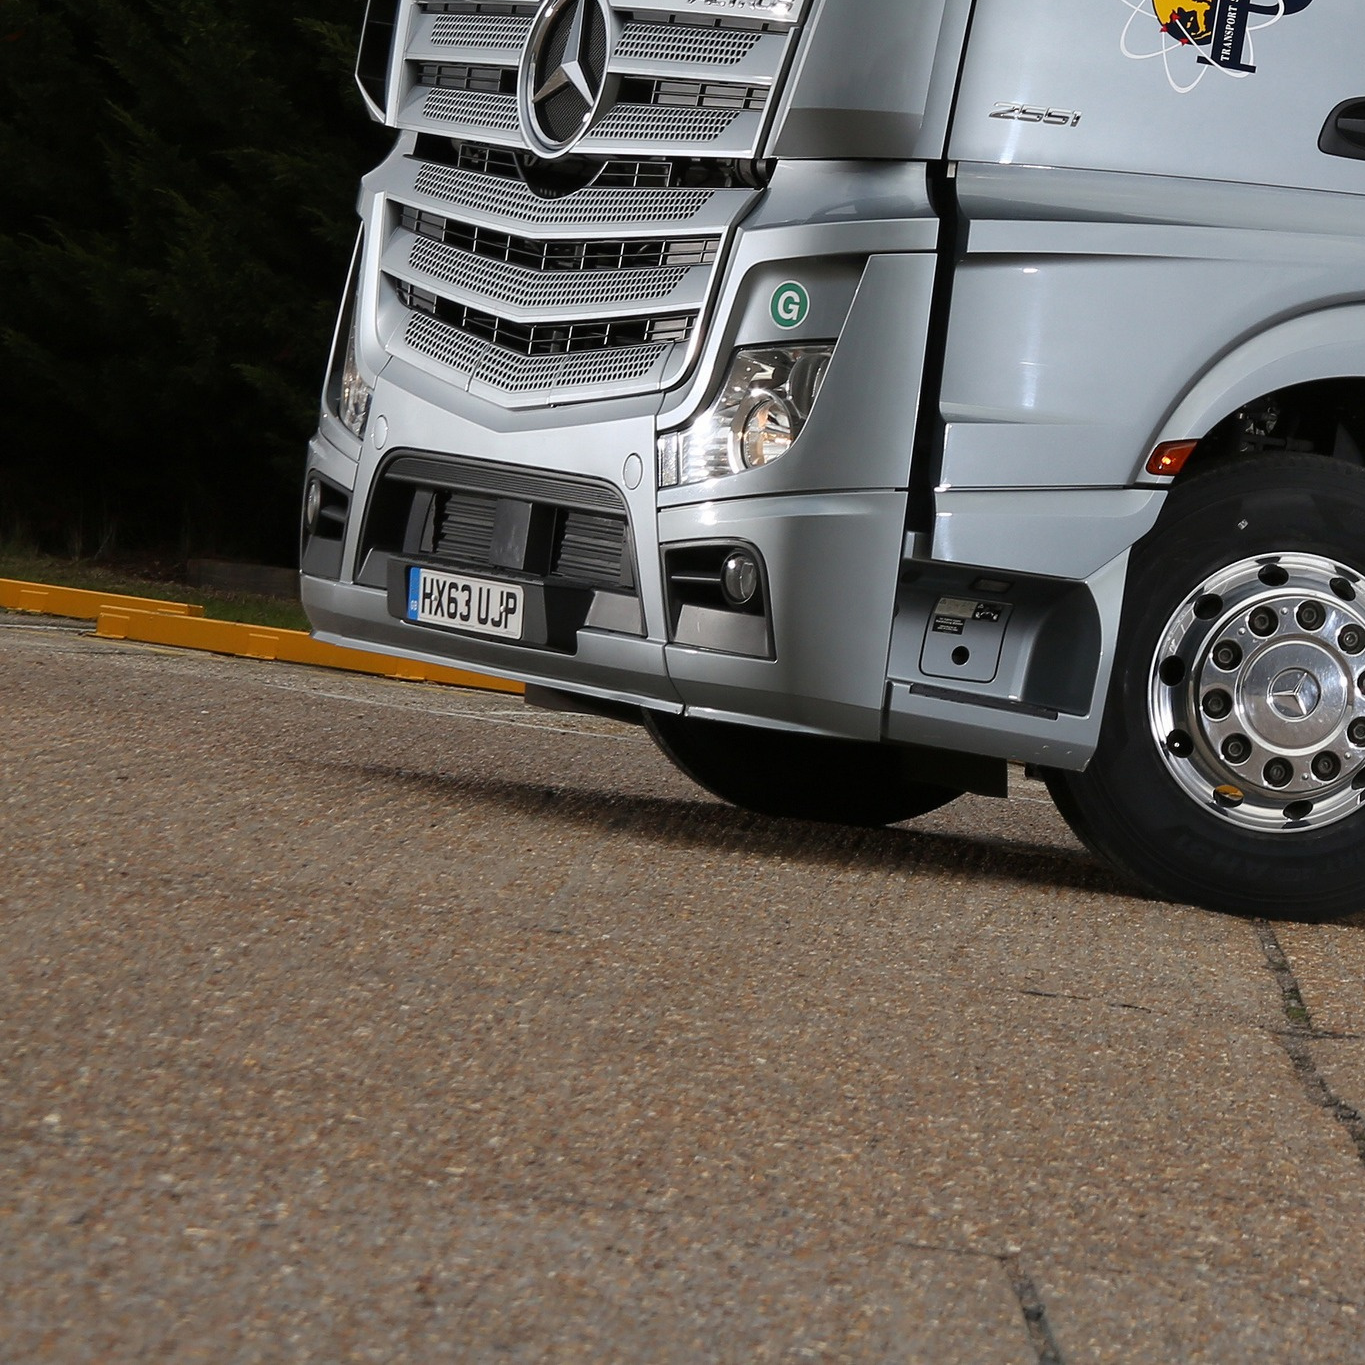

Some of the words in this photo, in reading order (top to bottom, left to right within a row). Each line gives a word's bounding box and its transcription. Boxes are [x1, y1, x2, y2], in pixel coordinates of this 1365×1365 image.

[1220, 5, 1238, 61] TRANSPORT
[988, 101, 1082, 127] 2551
[778, 290, 800, 320] G
[421, 576, 472, 622] HX63
[477, 586, 517, 629] UJP
